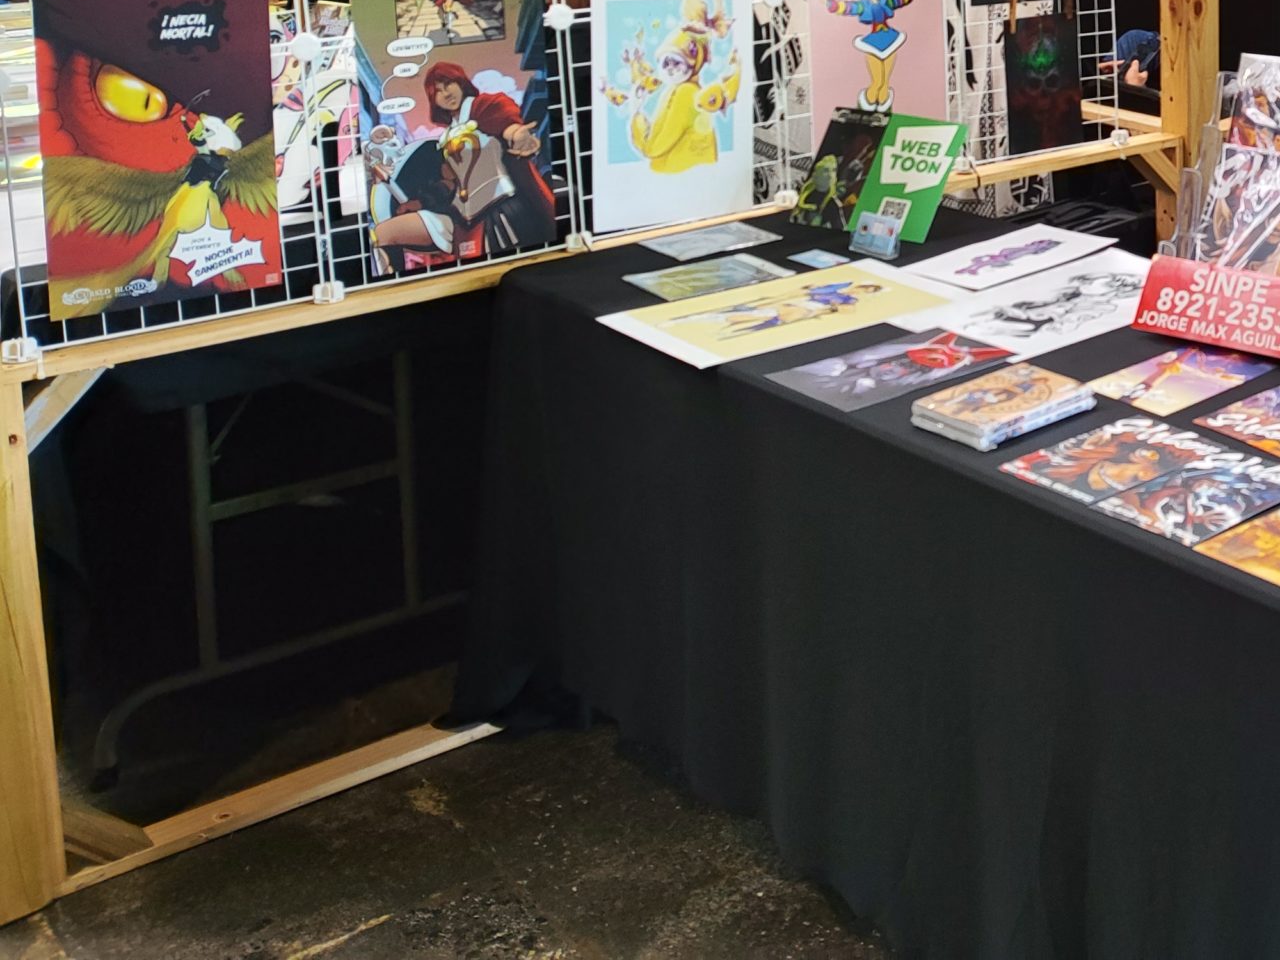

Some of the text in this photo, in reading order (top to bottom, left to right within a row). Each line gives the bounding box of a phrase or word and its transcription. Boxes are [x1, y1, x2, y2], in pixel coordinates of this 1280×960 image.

[160, 24, 215, 41] MORTAL!
[900, 139, 942, 158] WEB
[890, 153, 942, 174] TOON
[204, 245, 234, 262] NOCHE
[1189, 267, 1271, 304] SINPE
[1137, 309, 1189, 333] JORGE
[1190, 319, 1228, 340] MAX
